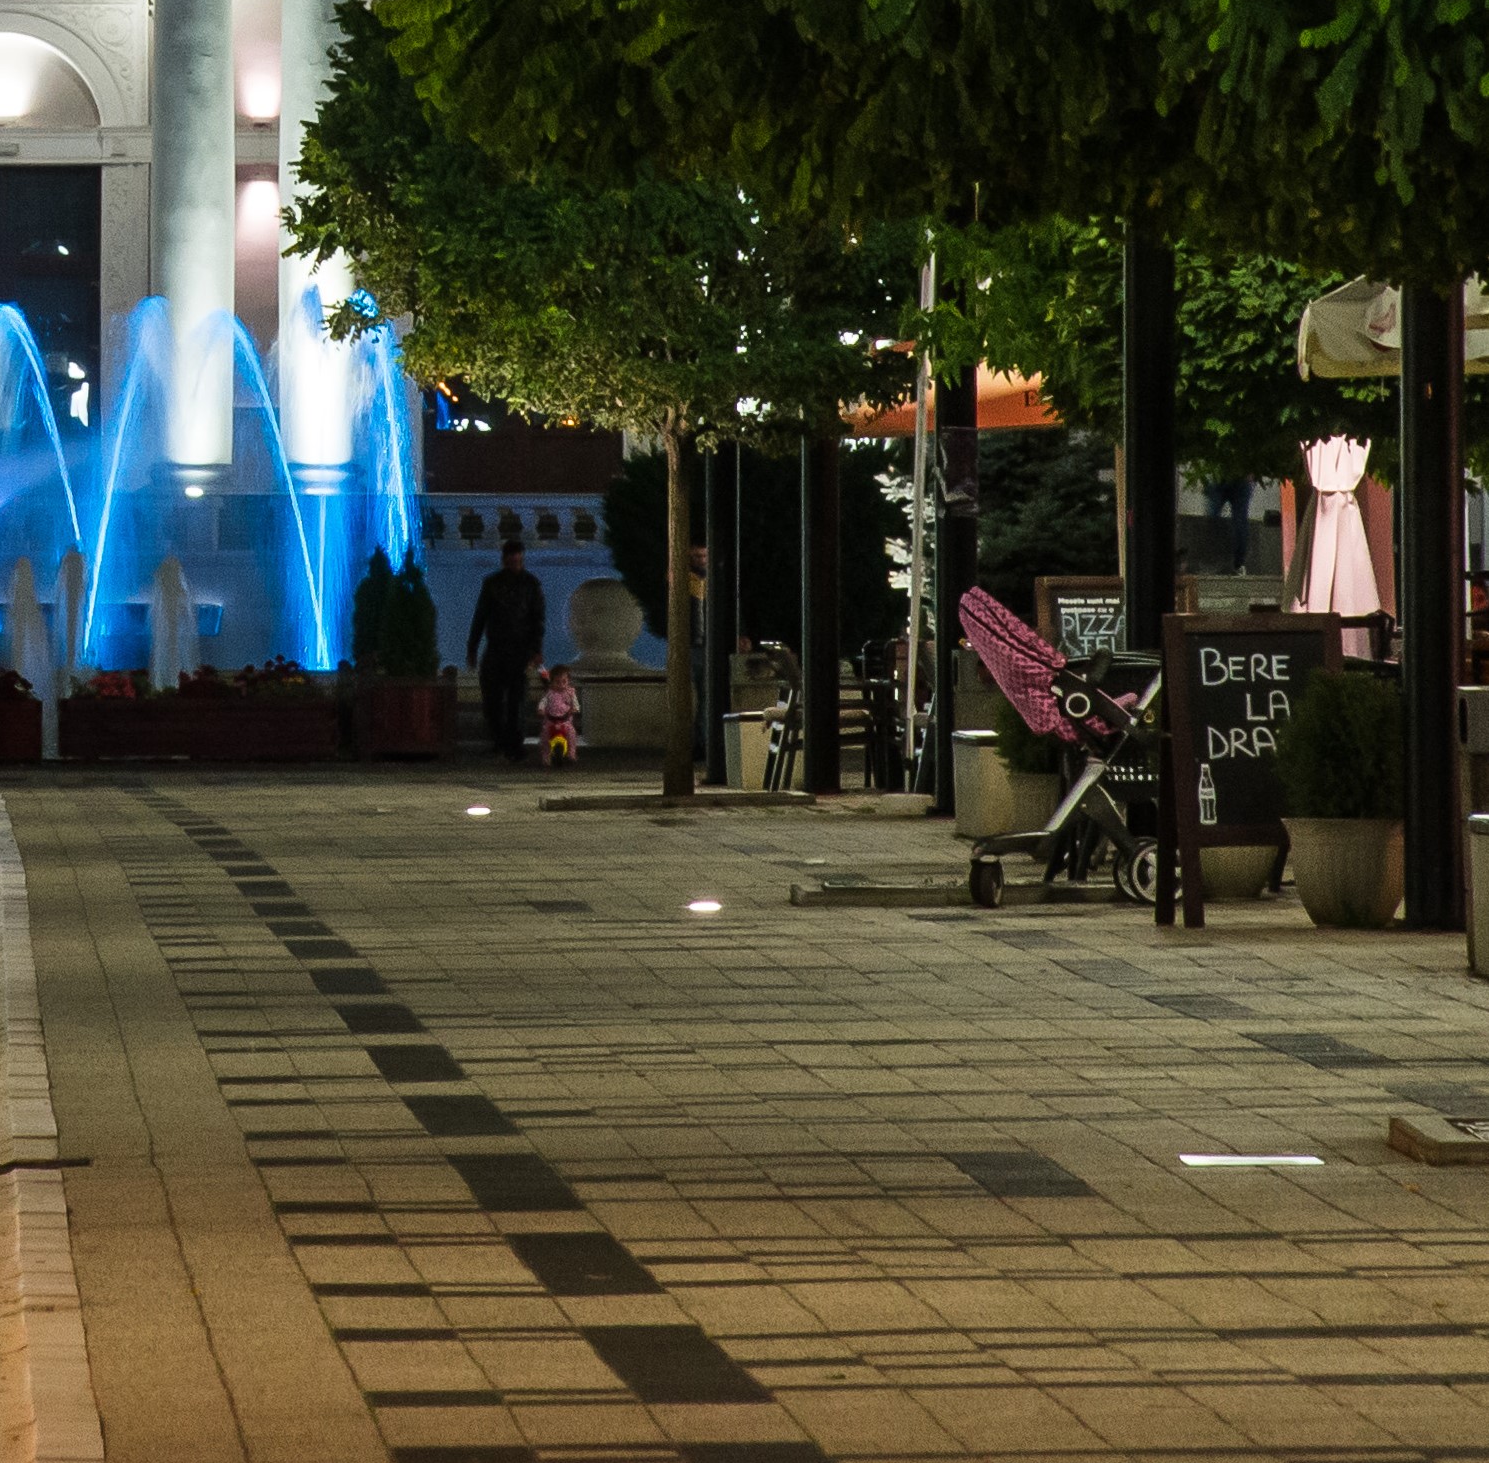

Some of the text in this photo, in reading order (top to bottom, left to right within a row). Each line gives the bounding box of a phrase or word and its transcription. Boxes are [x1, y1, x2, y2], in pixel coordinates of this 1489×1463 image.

[1199, 647, 1291, 686] BERE
[1245, 690, 1291, 721] LA
[1207, 726, 1280, 760] DRA
